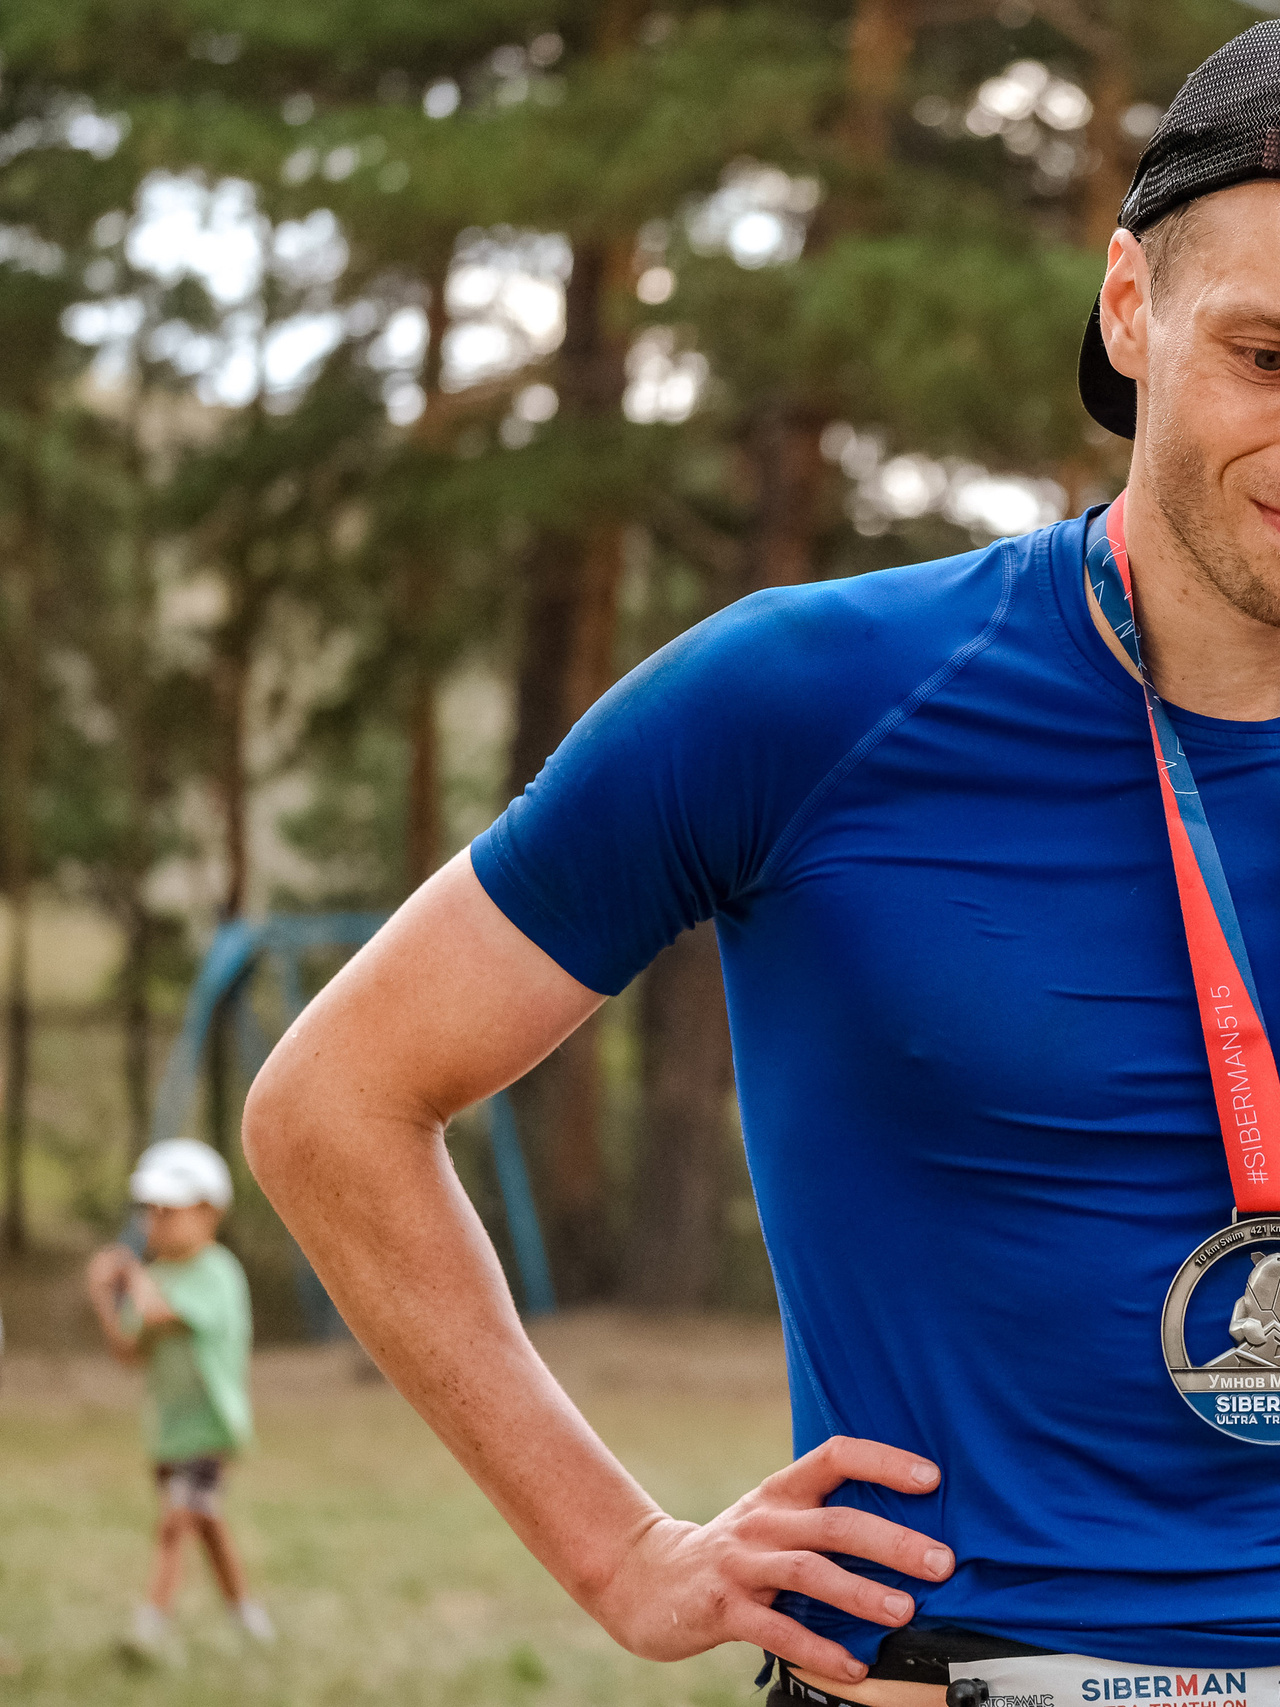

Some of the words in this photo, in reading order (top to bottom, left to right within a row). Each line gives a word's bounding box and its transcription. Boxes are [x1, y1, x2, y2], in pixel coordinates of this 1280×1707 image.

[1209, 984, 1269, 1185] #SIBERMAN515
[1195, 1254, 1207, 1265] 10
[1204, 1243, 1220, 1256] km
[1219, 1231, 1244, 1247] Swim
[1250, 1225, 1267, 1234] 421
[1208, 1374, 1265, 1389] Умнов
[1216, 1413, 1258, 1425] ULTRA
[1081, 1672, 1247, 1702] SIBERMAN
